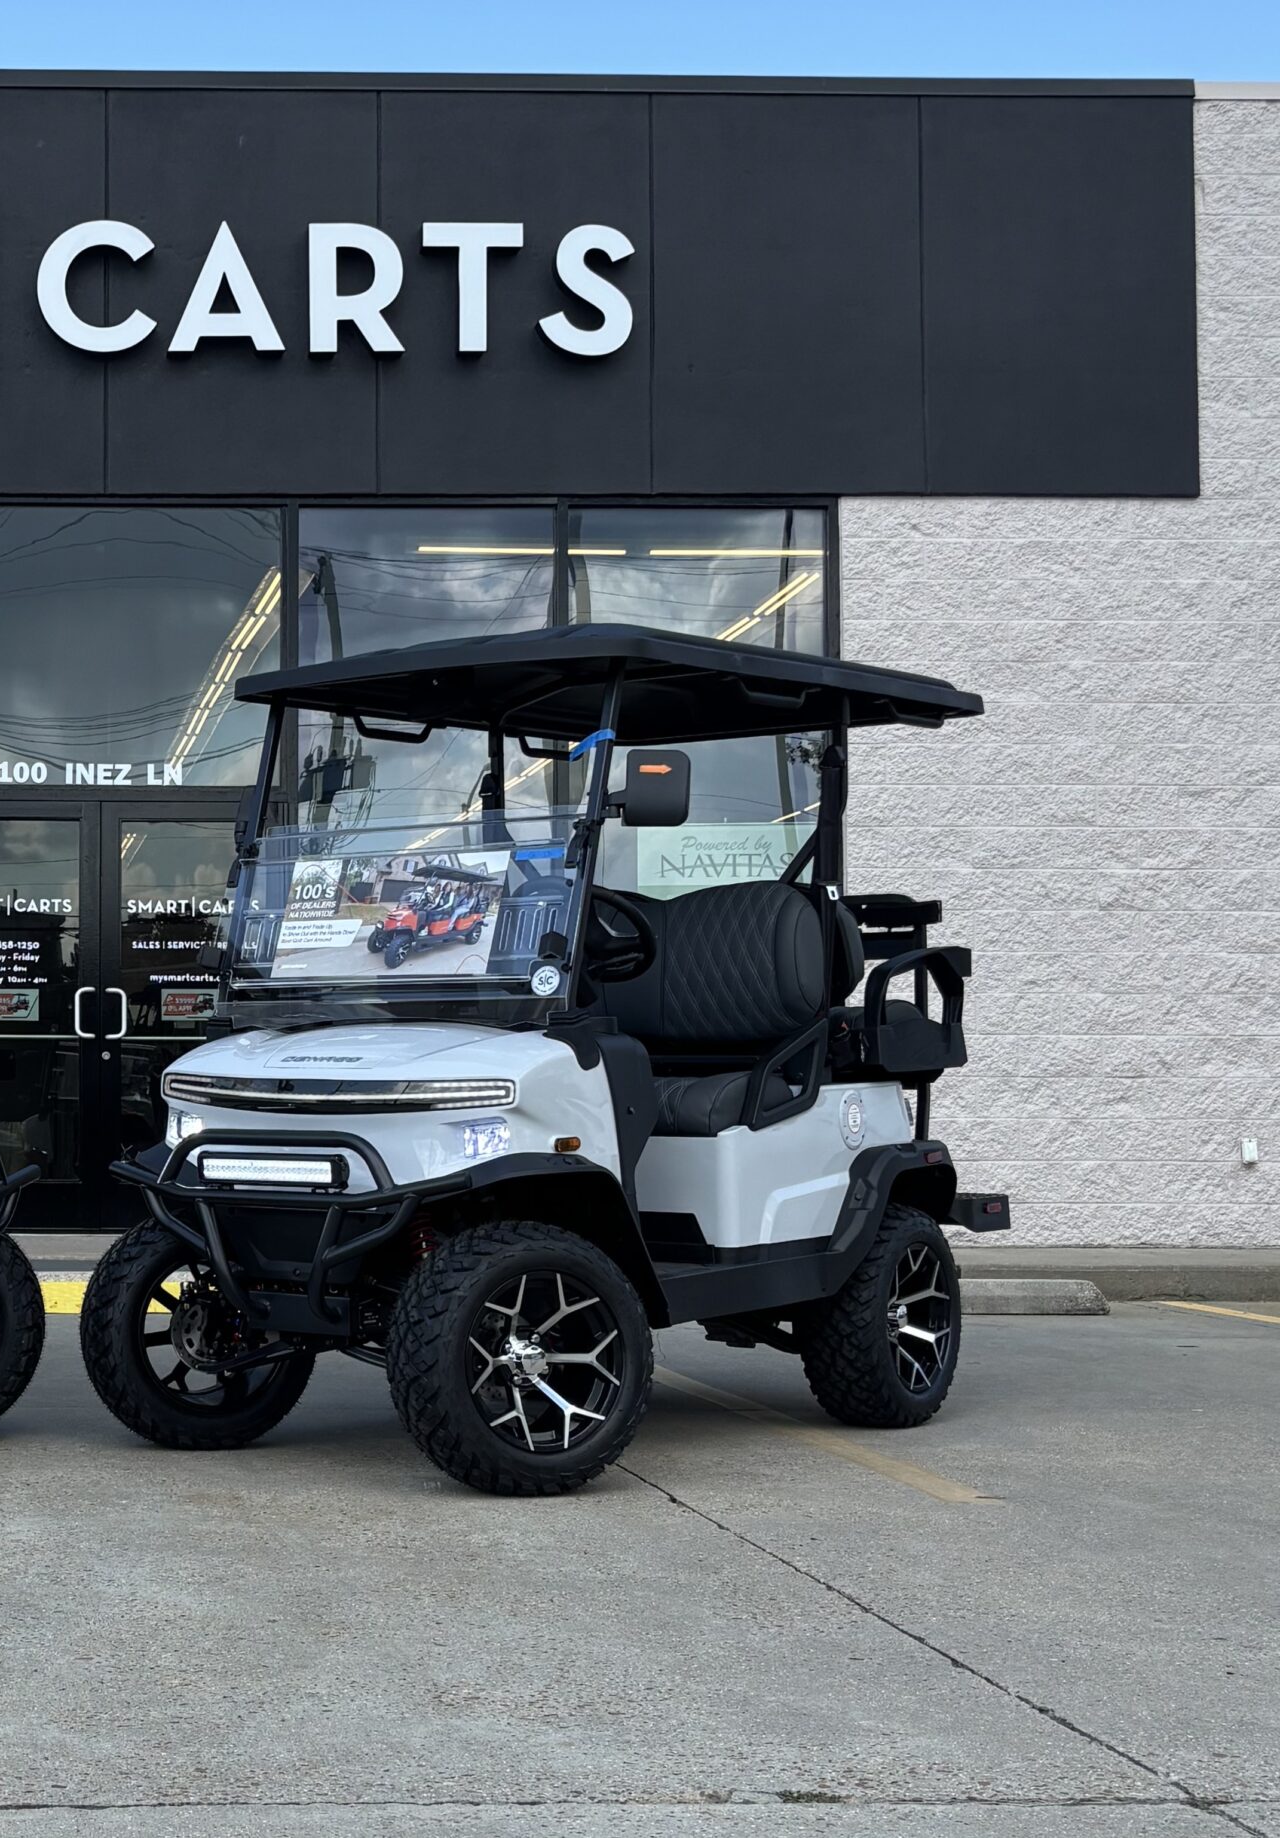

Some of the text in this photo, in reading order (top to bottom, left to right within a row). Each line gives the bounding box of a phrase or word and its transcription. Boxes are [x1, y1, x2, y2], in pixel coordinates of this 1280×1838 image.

[36, 219, 636, 357] CARTS
[65, 762, 132, 785] INEZ
[147, 763, 183, 786] LN
[681, 835, 773, 854] Powered by
[13, 898, 73, 913] CARTS
[127, 899, 261, 914] SMART CARS
[290, 900, 337, 910] OF DEALERS
[288, 910, 335, 919] NATIONWIDE
[131, 941, 161, 950] SALES
[12, 952, 40, 963] Friday
